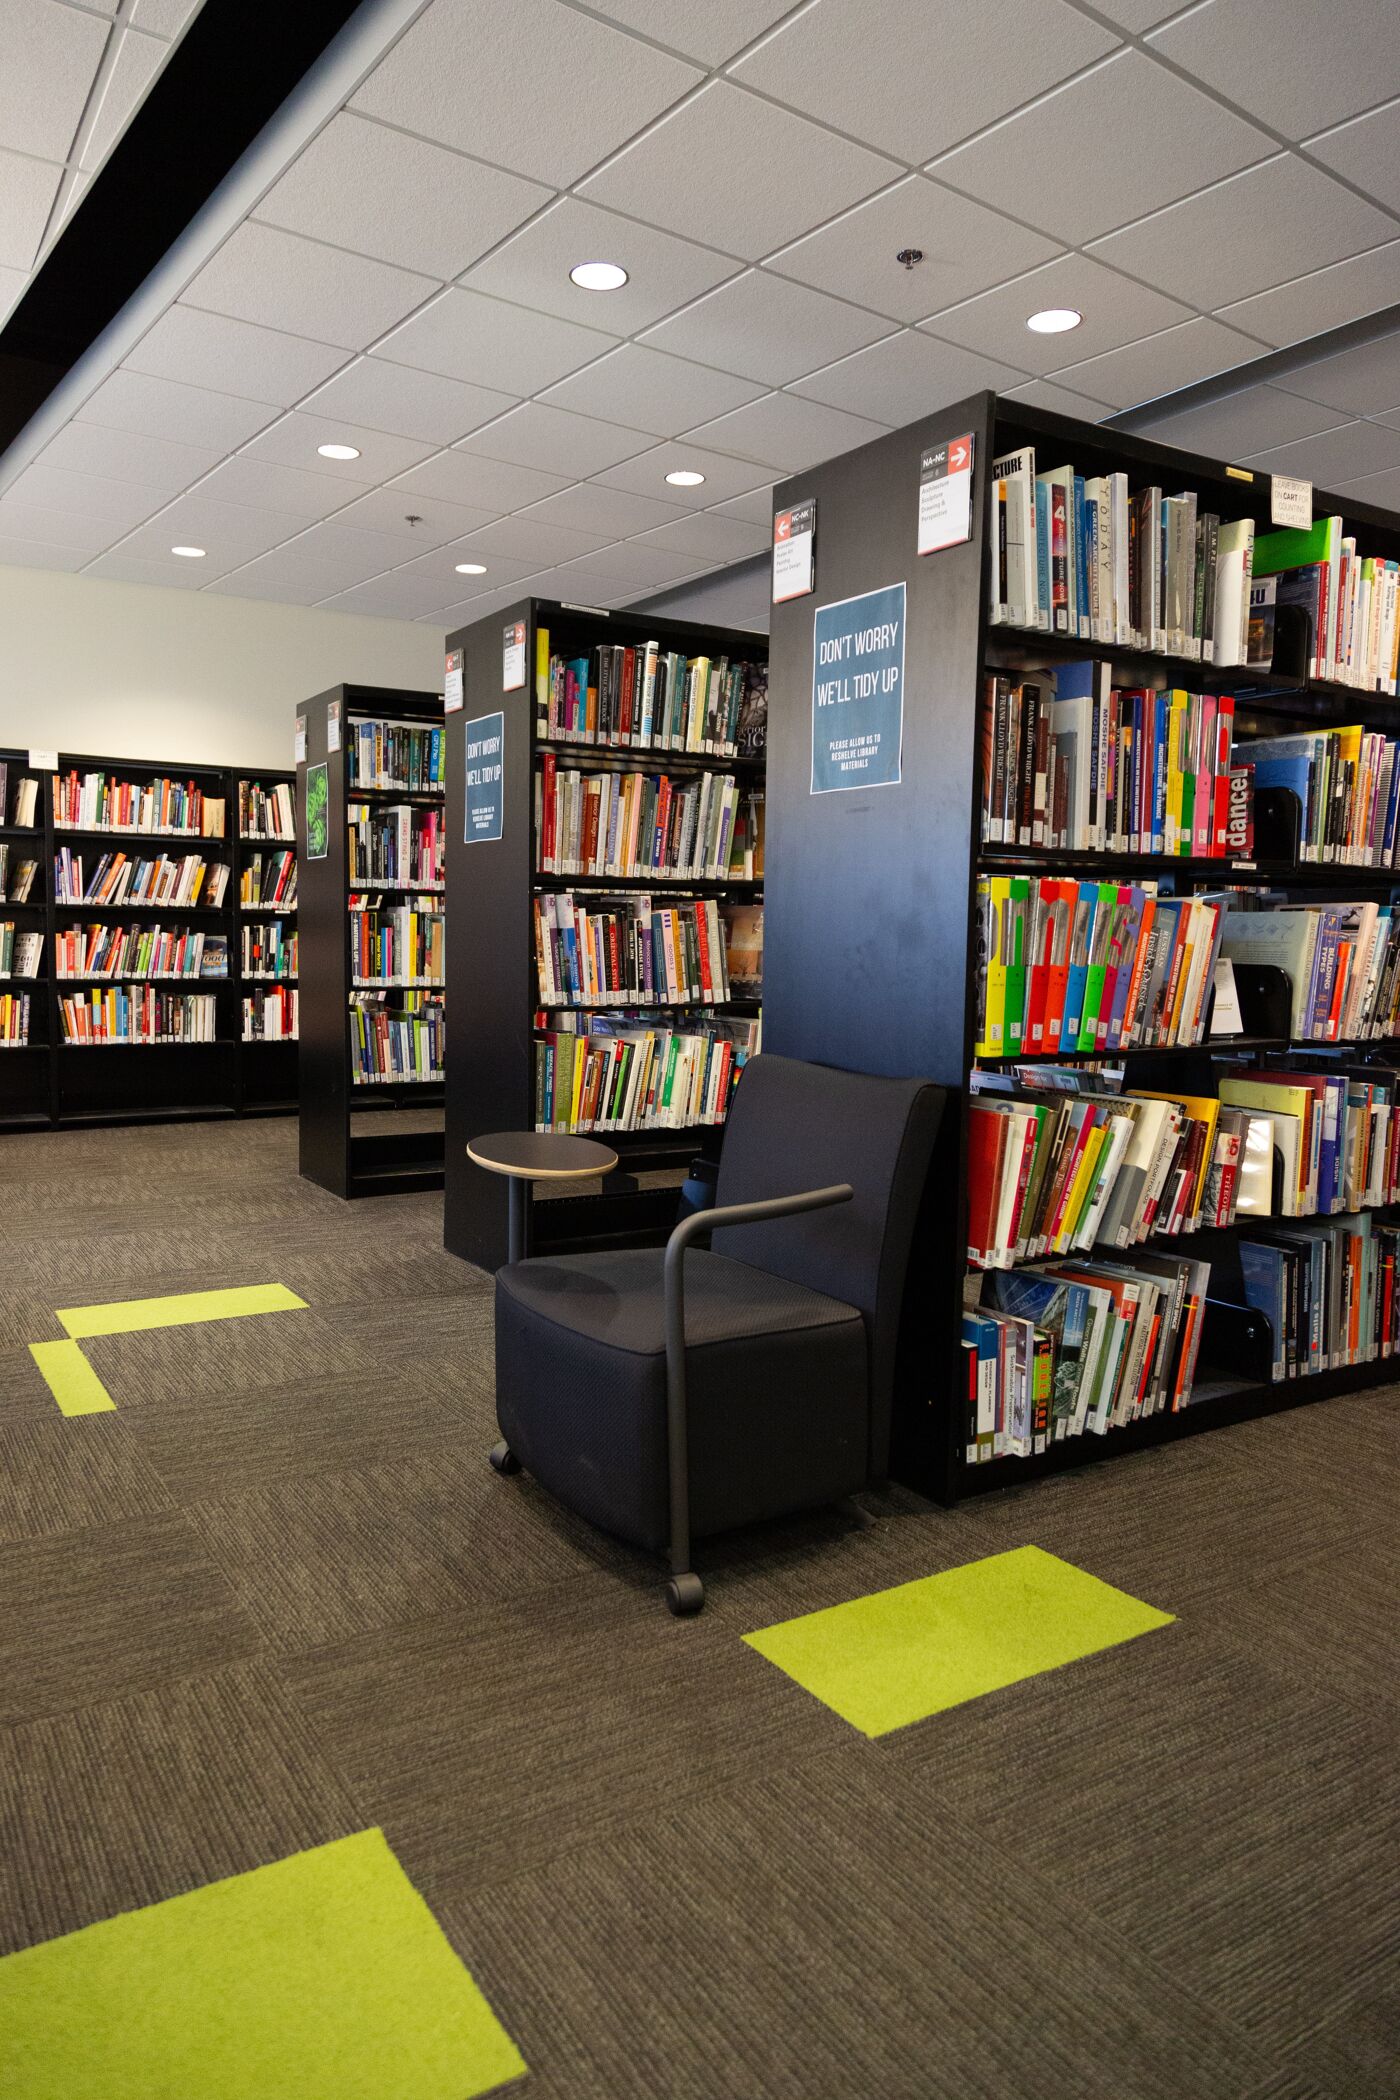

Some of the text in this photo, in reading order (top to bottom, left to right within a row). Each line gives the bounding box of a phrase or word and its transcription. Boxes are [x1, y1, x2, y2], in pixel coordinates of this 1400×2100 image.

[923, 452, 946, 468] NA-NC
[1283, 492, 1298, 502] CART
[1291, 481, 1310, 492] BOOKS
[792, 510, 810, 522] NC-NK
[1054, 506, 1066, 522] 4
[1278, 502, 1305, 514] COUNTING
[1038, 510, 1046, 578] ARCHITECTURE
[1100, 489, 1109, 569] TODAY
[820, 622, 898, 665] DON'T WORRY
[818, 666, 898, 707] WE'LL TIDY UP
[468, 736, 500, 760] DON'T WORRY
[830, 733, 880, 752] PLEASE ALLOW US TO
[831, 746, 878, 762] RESHELVE LIBRARY
[1100, 708, 1109, 790] MOSHE SAFDIE
[467, 764, 501, 786] WE'LL TIDY UP
[840, 758, 868, 772] MATERIALS
[996, 750, 1004, 780] WRIGHT
[1024, 754, 1033, 784] WRIGHT
[1090, 750, 1098, 790] SAFDIE
[1136, 932, 1148, 971] ARCHITECTURE
[1158, 930, 1170, 968] RUSSIAN
[1320, 946, 1328, 973] TYPES
[1170, 944, 1184, 986] ARCHITECTURE
[1324, 948, 1336, 990] BUILDING
[1126, 990, 1139, 1026] NETHERLANDS
[1167, 994, 1176, 1012] SPAIN
[1056, 1148, 1072, 1188] Classic Thai
[1066, 1148, 1084, 1193] ARCHITECTURE
[1142, 1138, 1169, 1204] DESIGN PORTFOLIOS
[1204, 1127, 1220, 1185] Sustainable Design
[1058, 1200, 1070, 1220] CHINA
[1174, 1280, 1184, 1308] INTERIOR
[1314, 1302, 1320, 1310] &
[1172, 1309, 1180, 1330] SPACE
[1138, 1325, 1148, 1350] MATERIAL
[1070, 1318, 1094, 1410] Green Walls Green Roofs
[1130, 1352, 1142, 1386] REVOLUTION
